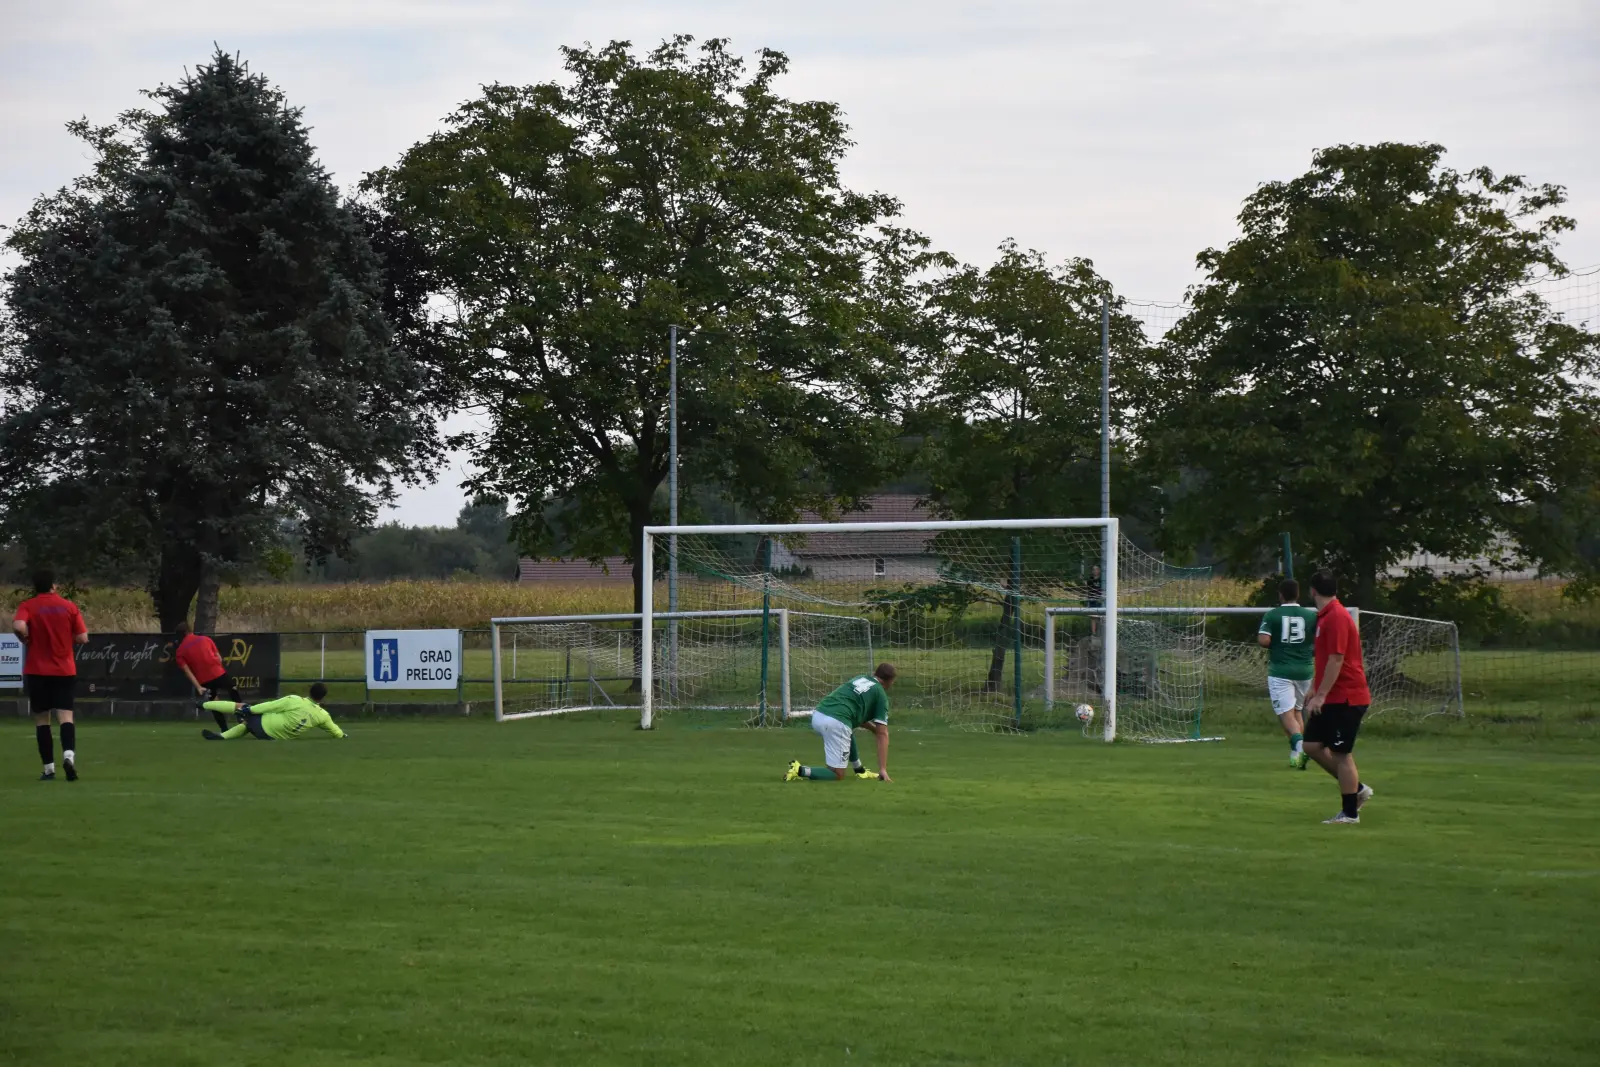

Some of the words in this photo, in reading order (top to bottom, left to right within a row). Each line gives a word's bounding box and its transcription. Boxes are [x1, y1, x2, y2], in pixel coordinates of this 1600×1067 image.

[1281, 615, 1306, 644] 13
[123, 641, 159, 670] eight
[420, 650, 452, 663] GRAD
[406, 668, 452, 681] PRELOG
